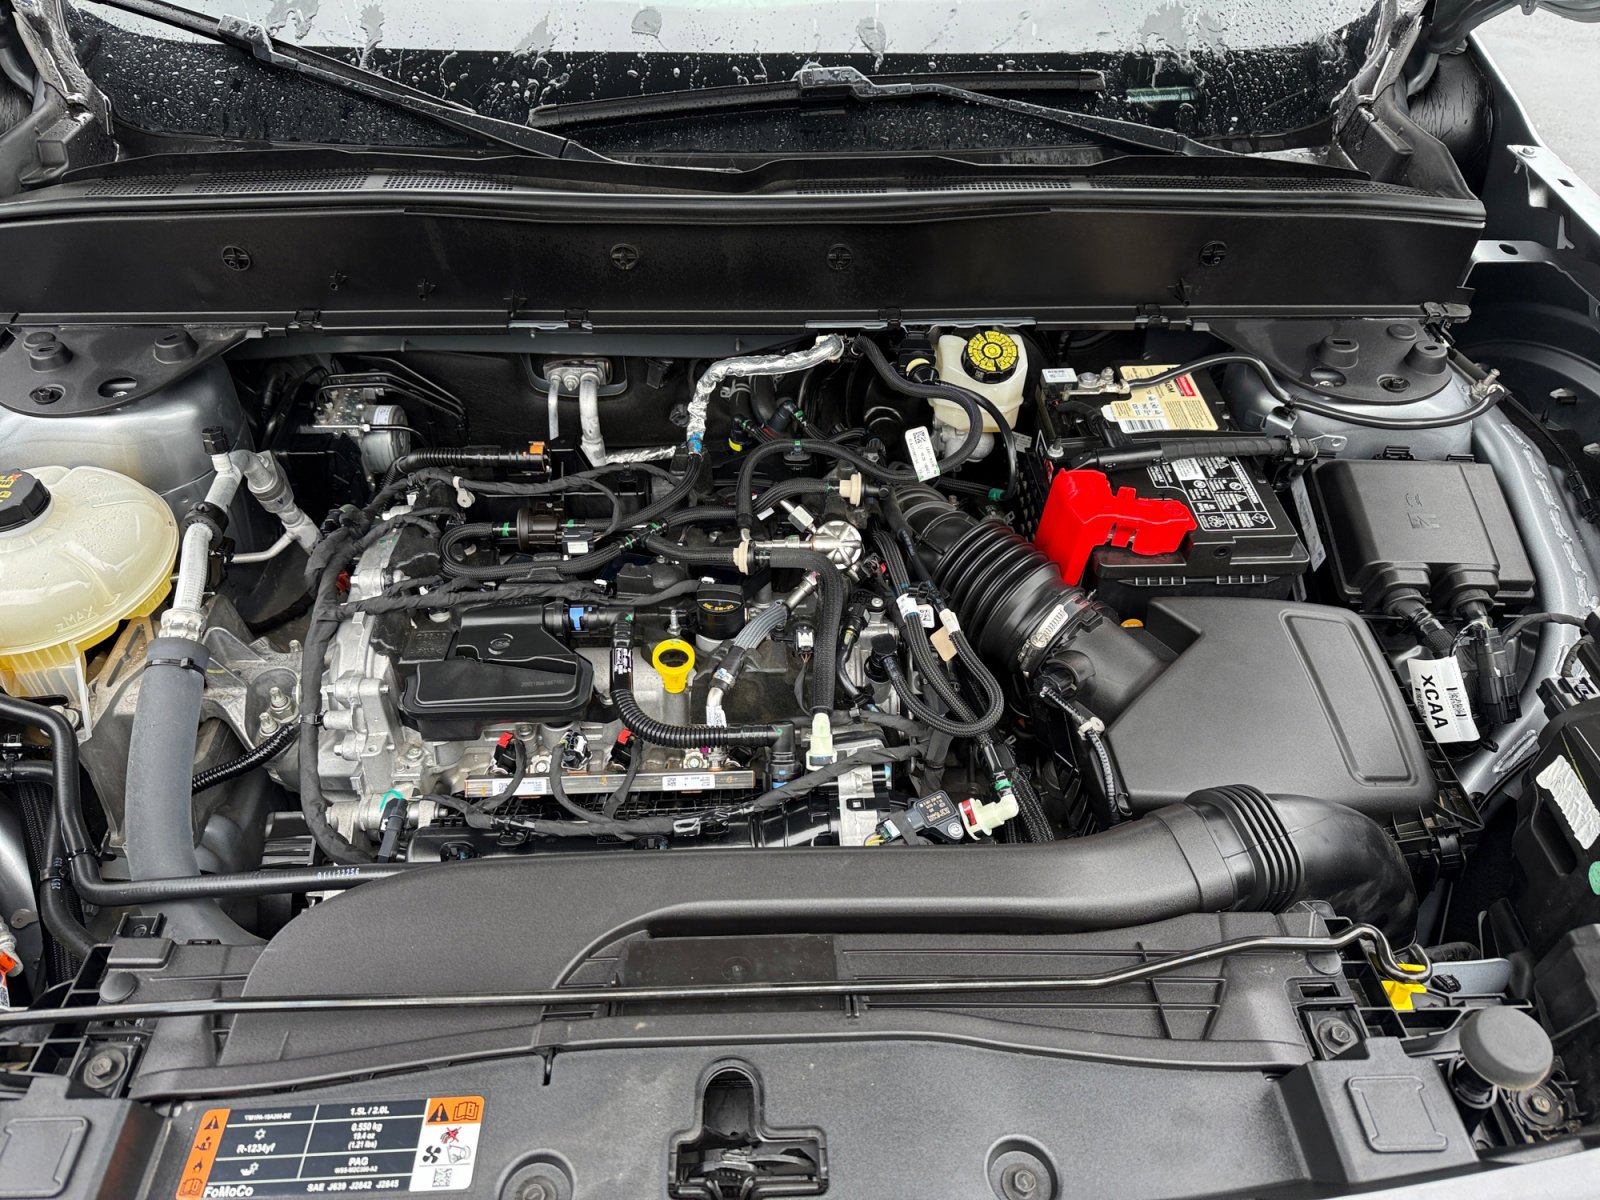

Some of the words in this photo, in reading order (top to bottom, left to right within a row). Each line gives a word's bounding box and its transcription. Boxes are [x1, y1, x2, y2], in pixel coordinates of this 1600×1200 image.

[1421, 674, 1449, 729] XCAA
[236, 1142, 277, 1155] R-1234yf
[348, 1156, 369, 1167] PAG
[202, 1184, 254, 1198] FoMoCo
[306, 1182, 326, 1193] SAE
